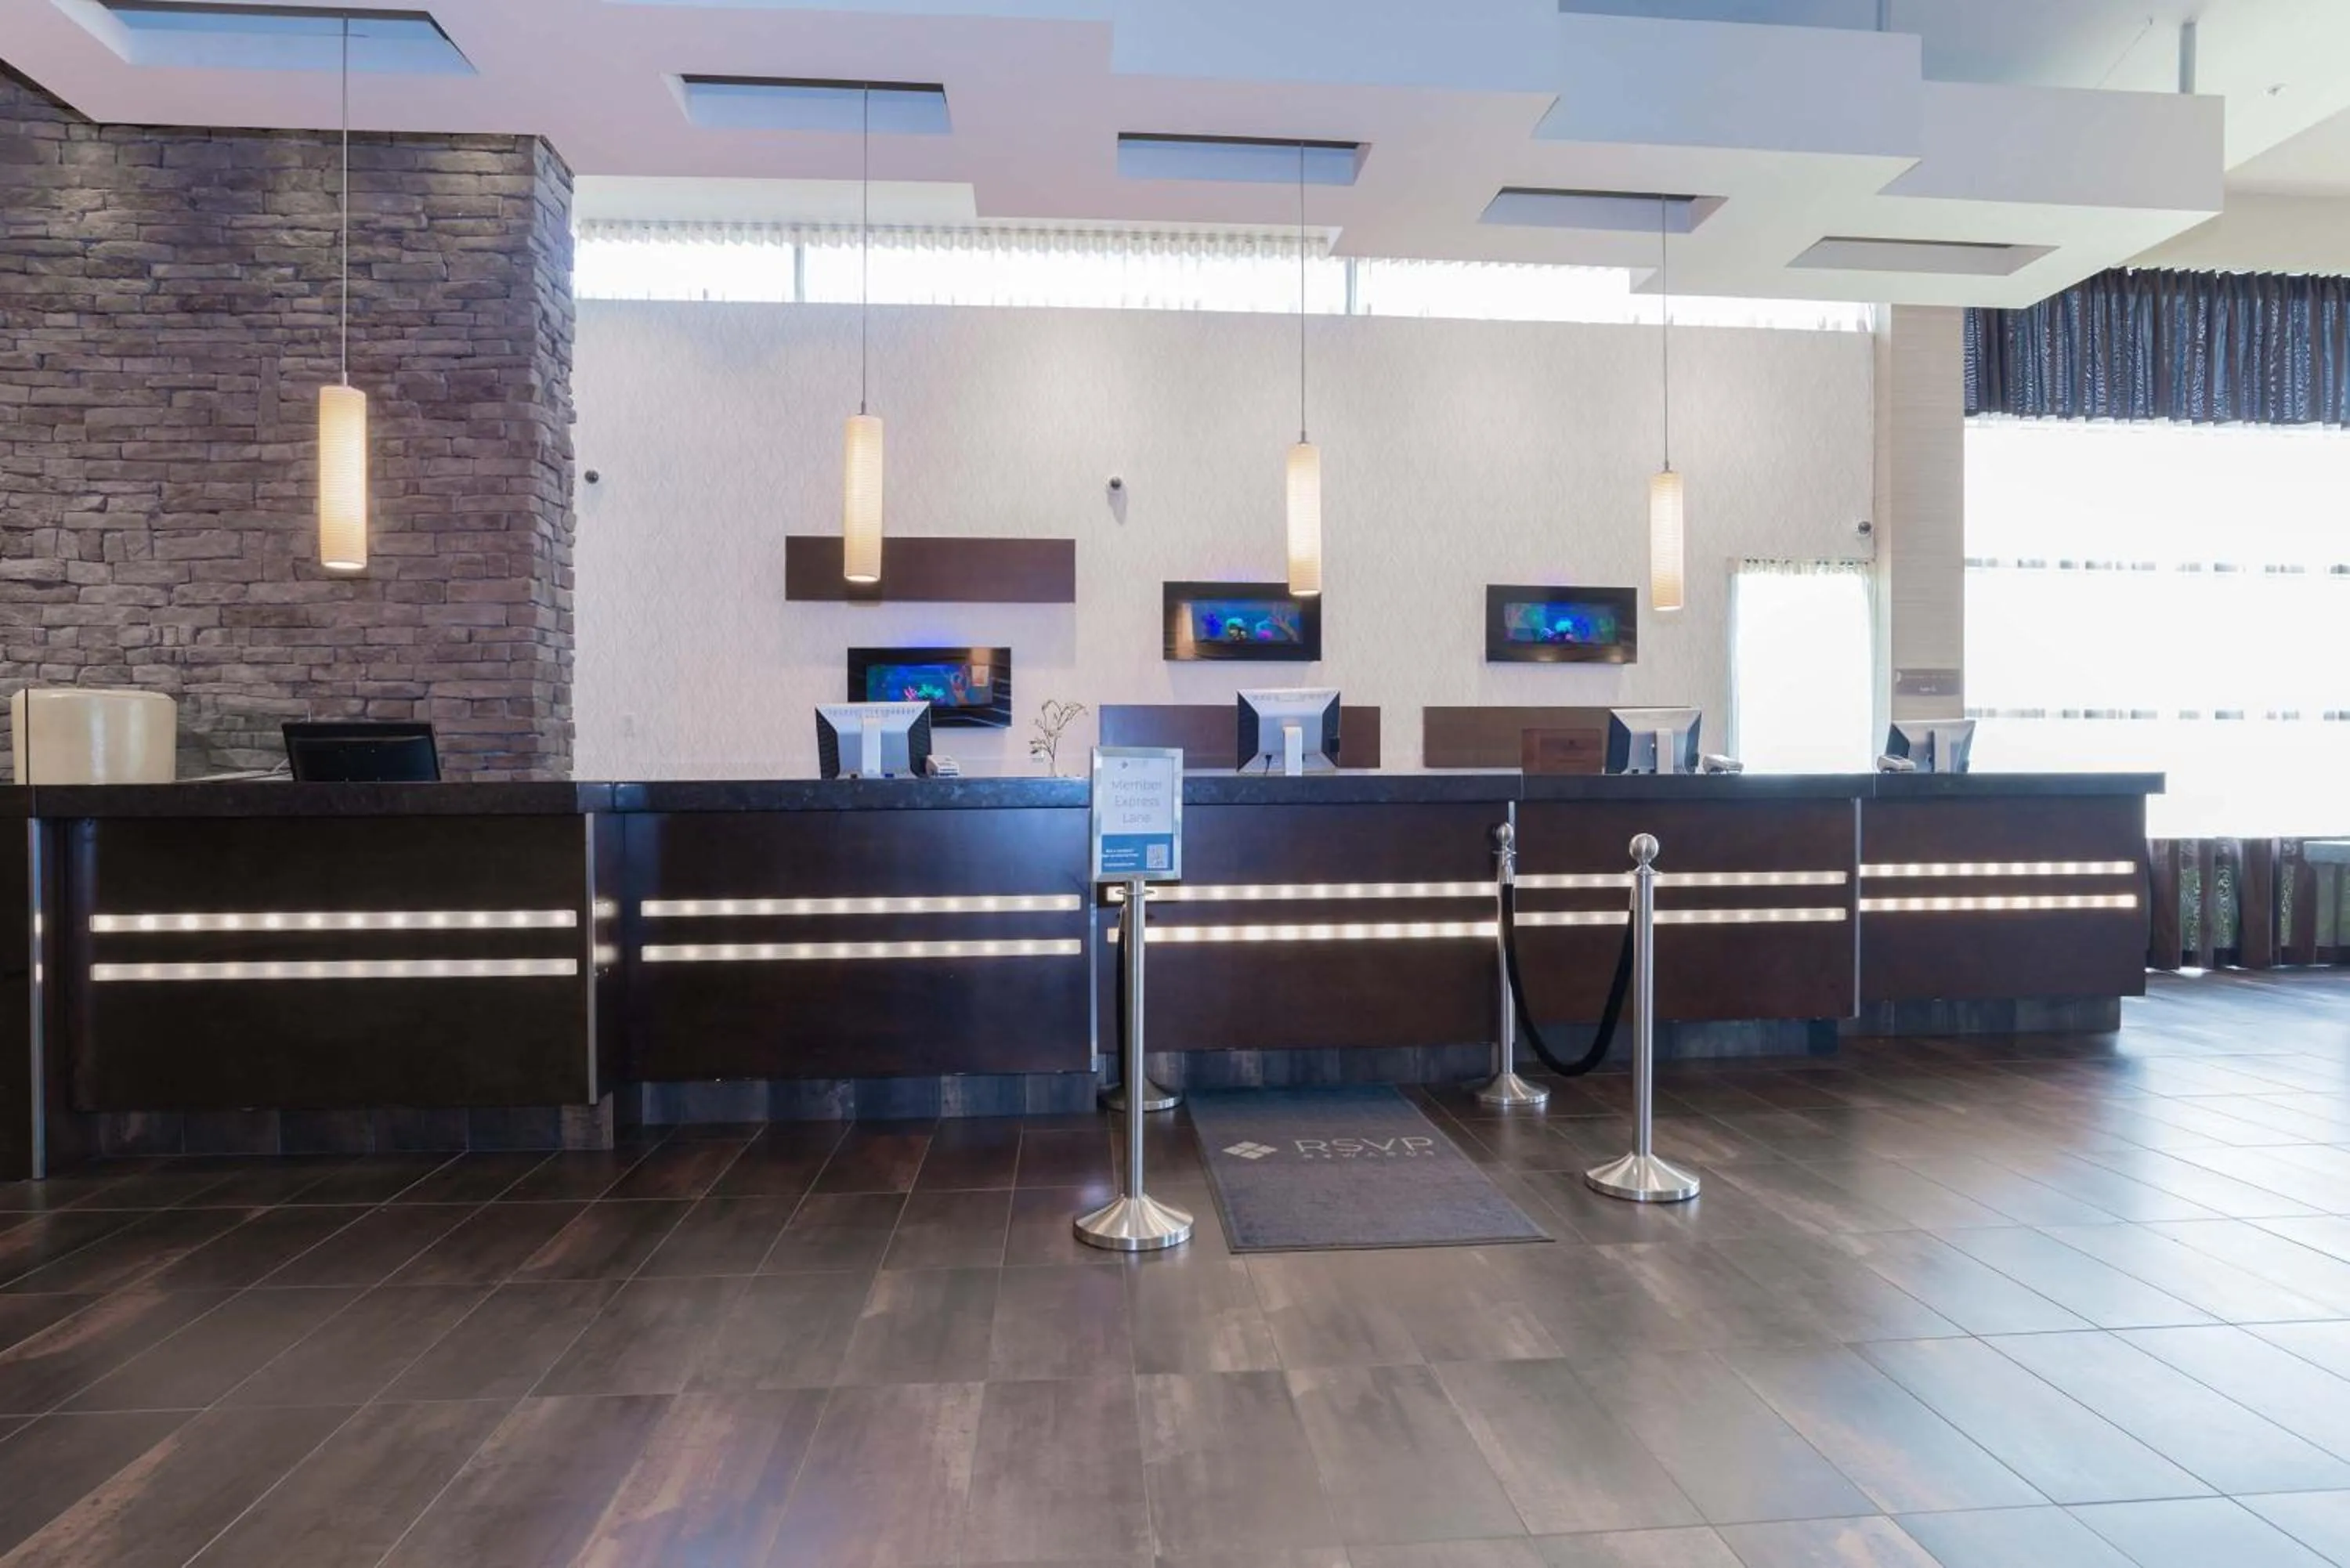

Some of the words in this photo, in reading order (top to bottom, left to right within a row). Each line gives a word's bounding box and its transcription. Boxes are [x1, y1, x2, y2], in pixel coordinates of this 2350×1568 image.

[1111, 778, 1162, 790] Member
[1115, 795, 1160, 808] Express
[1123, 813, 1152, 824] Lane
[1295, 1136, 1434, 1153] RSVP
